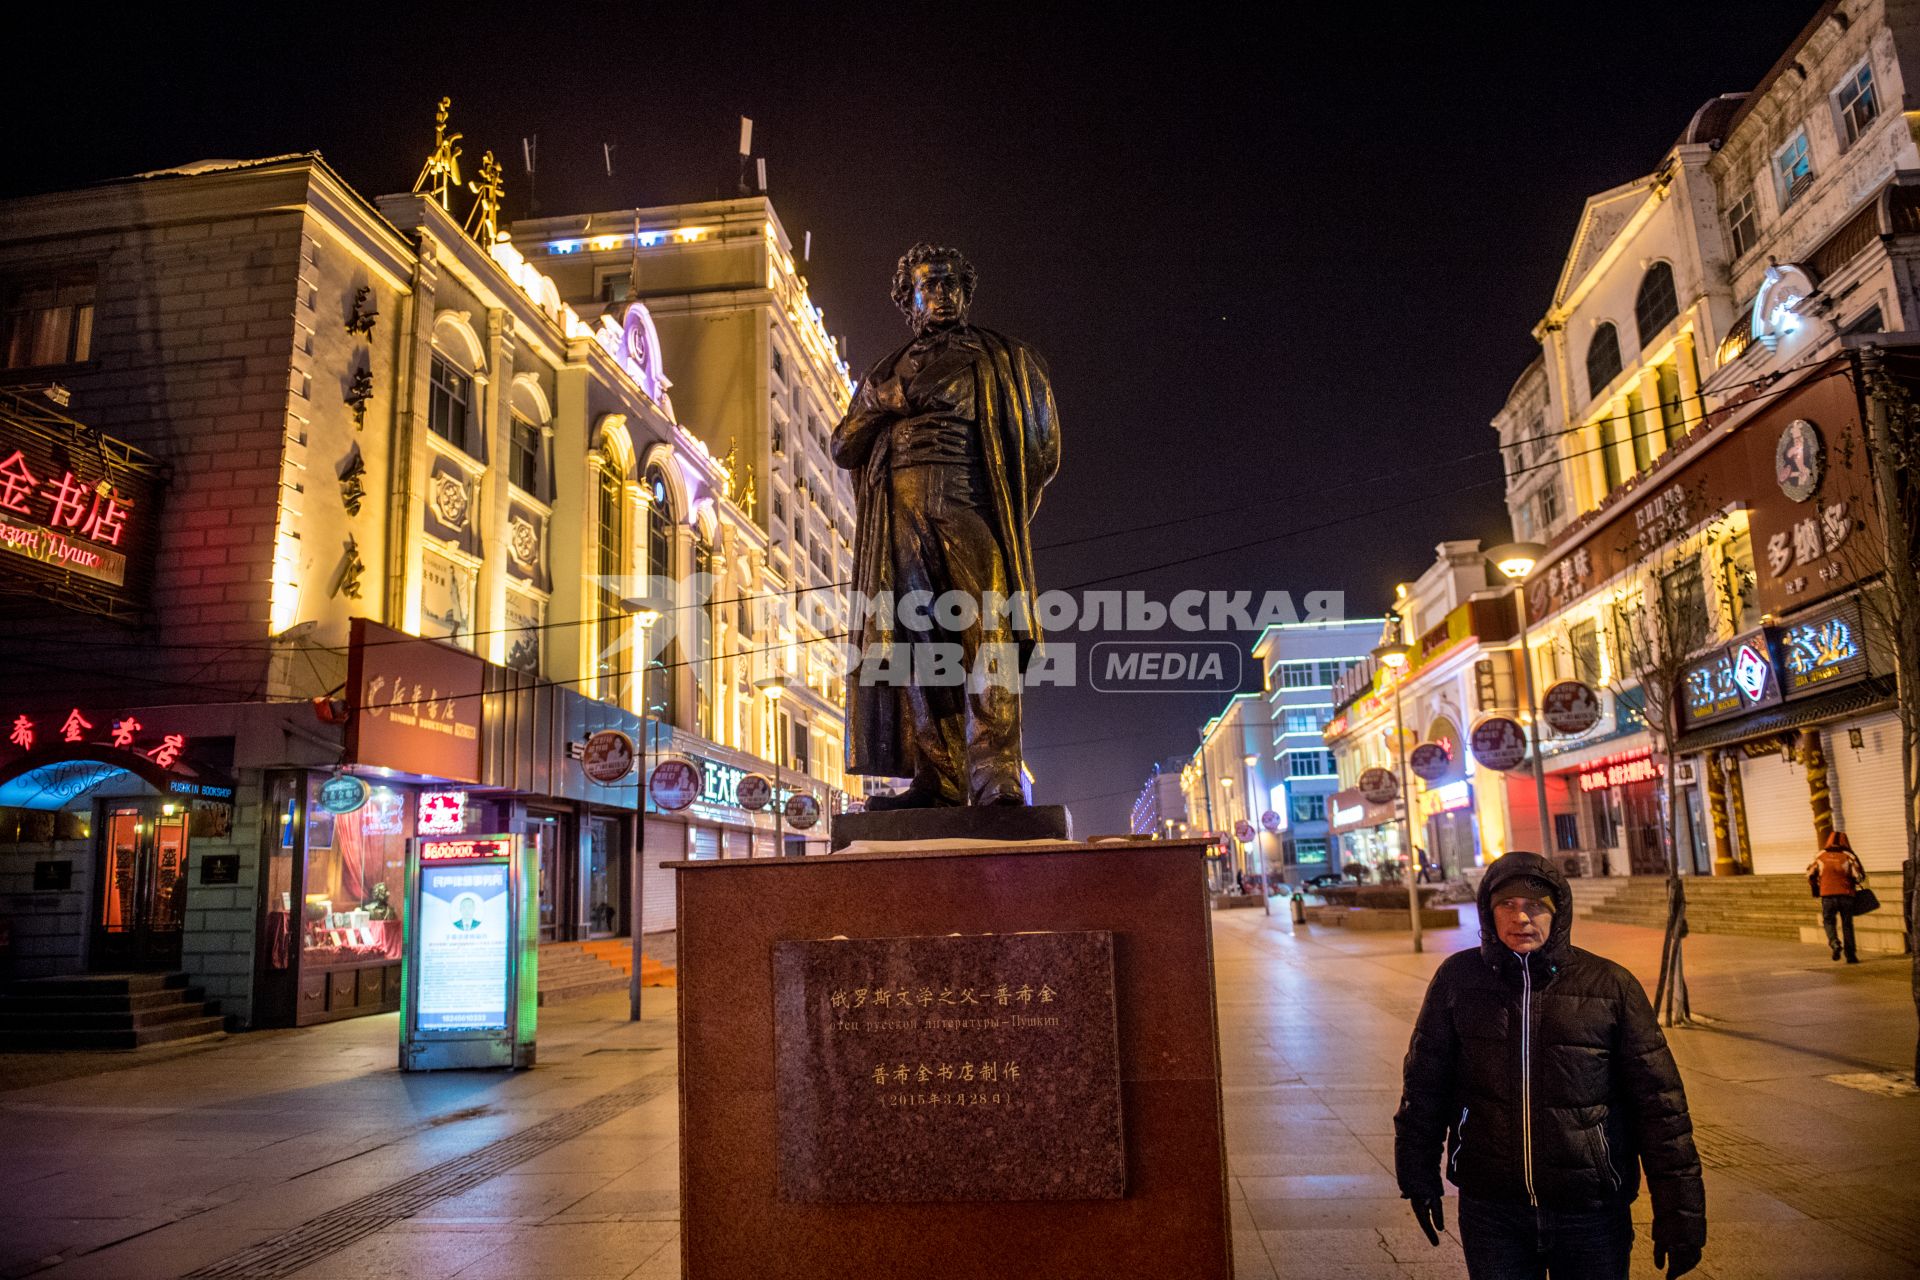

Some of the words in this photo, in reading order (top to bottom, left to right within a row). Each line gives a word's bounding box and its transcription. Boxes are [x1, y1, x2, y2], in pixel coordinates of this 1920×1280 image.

[0, 450, 135, 545] 金书店
[170, 781, 199, 794] PUSHKIN
[201, 785, 231, 798] BOOKSHOP
[871, 1061, 1021, 1085] 普希金书店制作
